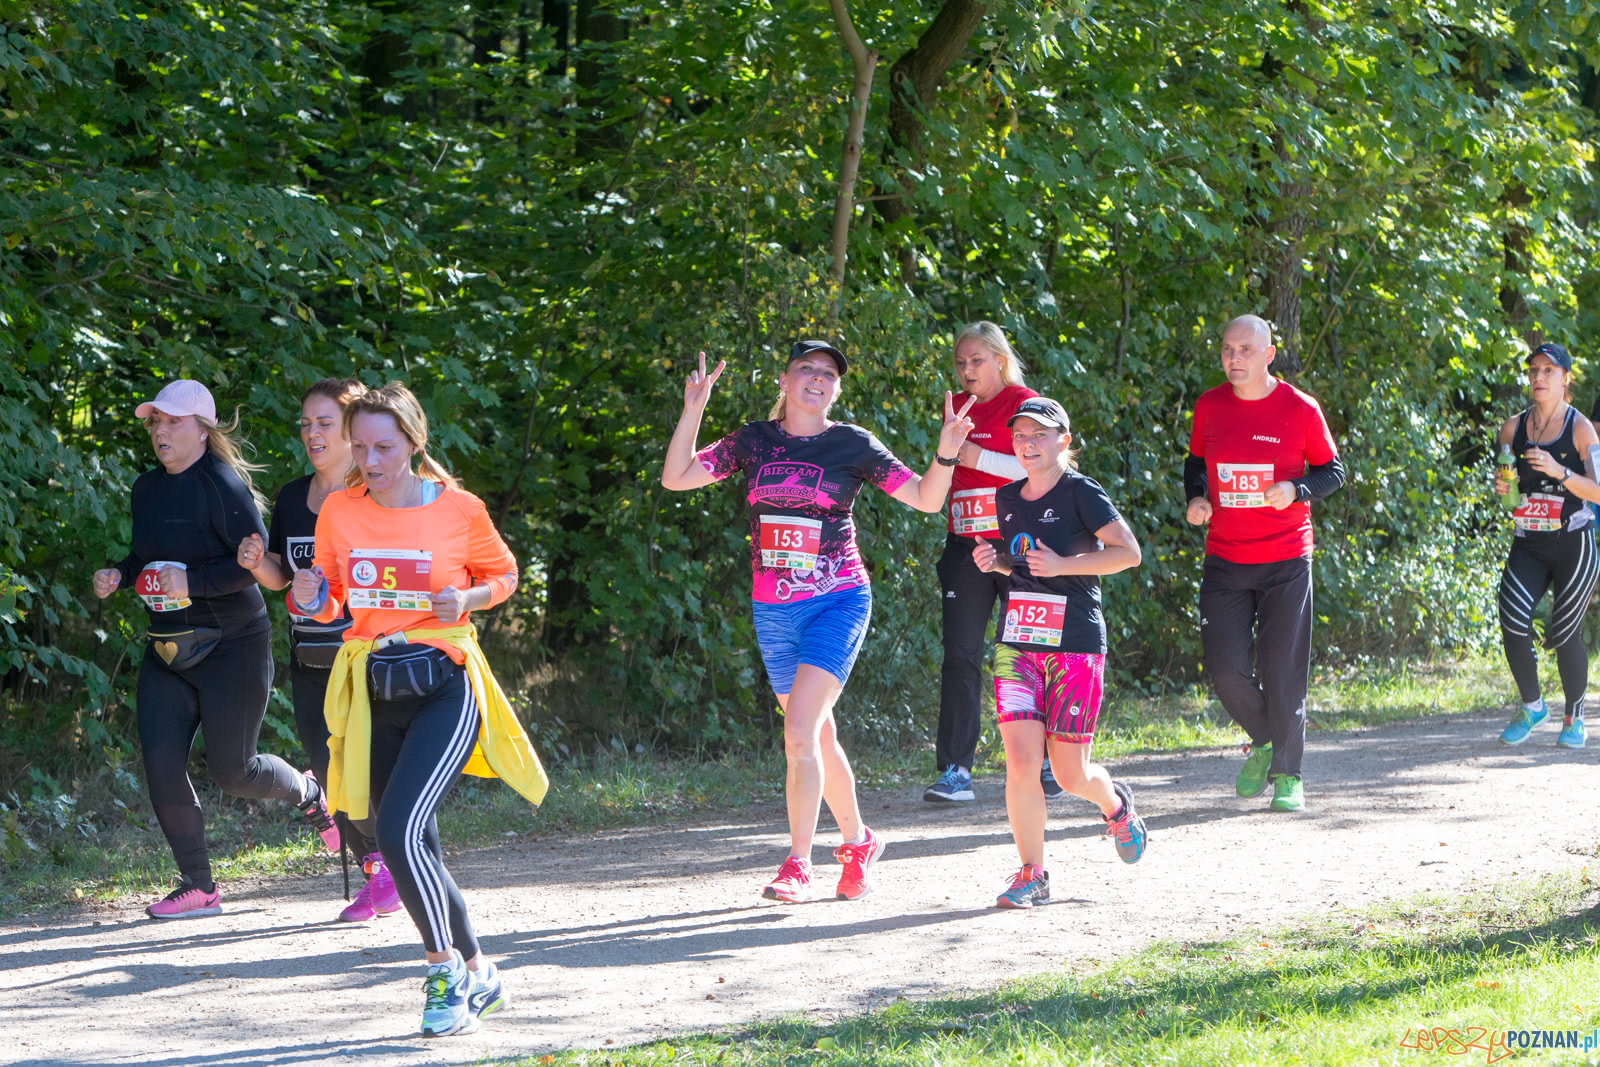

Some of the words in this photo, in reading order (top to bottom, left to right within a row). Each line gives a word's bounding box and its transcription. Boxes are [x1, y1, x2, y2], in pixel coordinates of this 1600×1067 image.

[1252, 434, 1281, 444] ANDRZEJ
[763, 466, 818, 478] BIEGAM
[1232, 475, 1259, 490] 183
[960, 500, 983, 516] 116
[1524, 502, 1549, 516] 223
[773, 529, 803, 548] 153
[145, 574, 160, 592] 36
[382, 566, 397, 590] 5
[1018, 604, 1047, 624] 152
